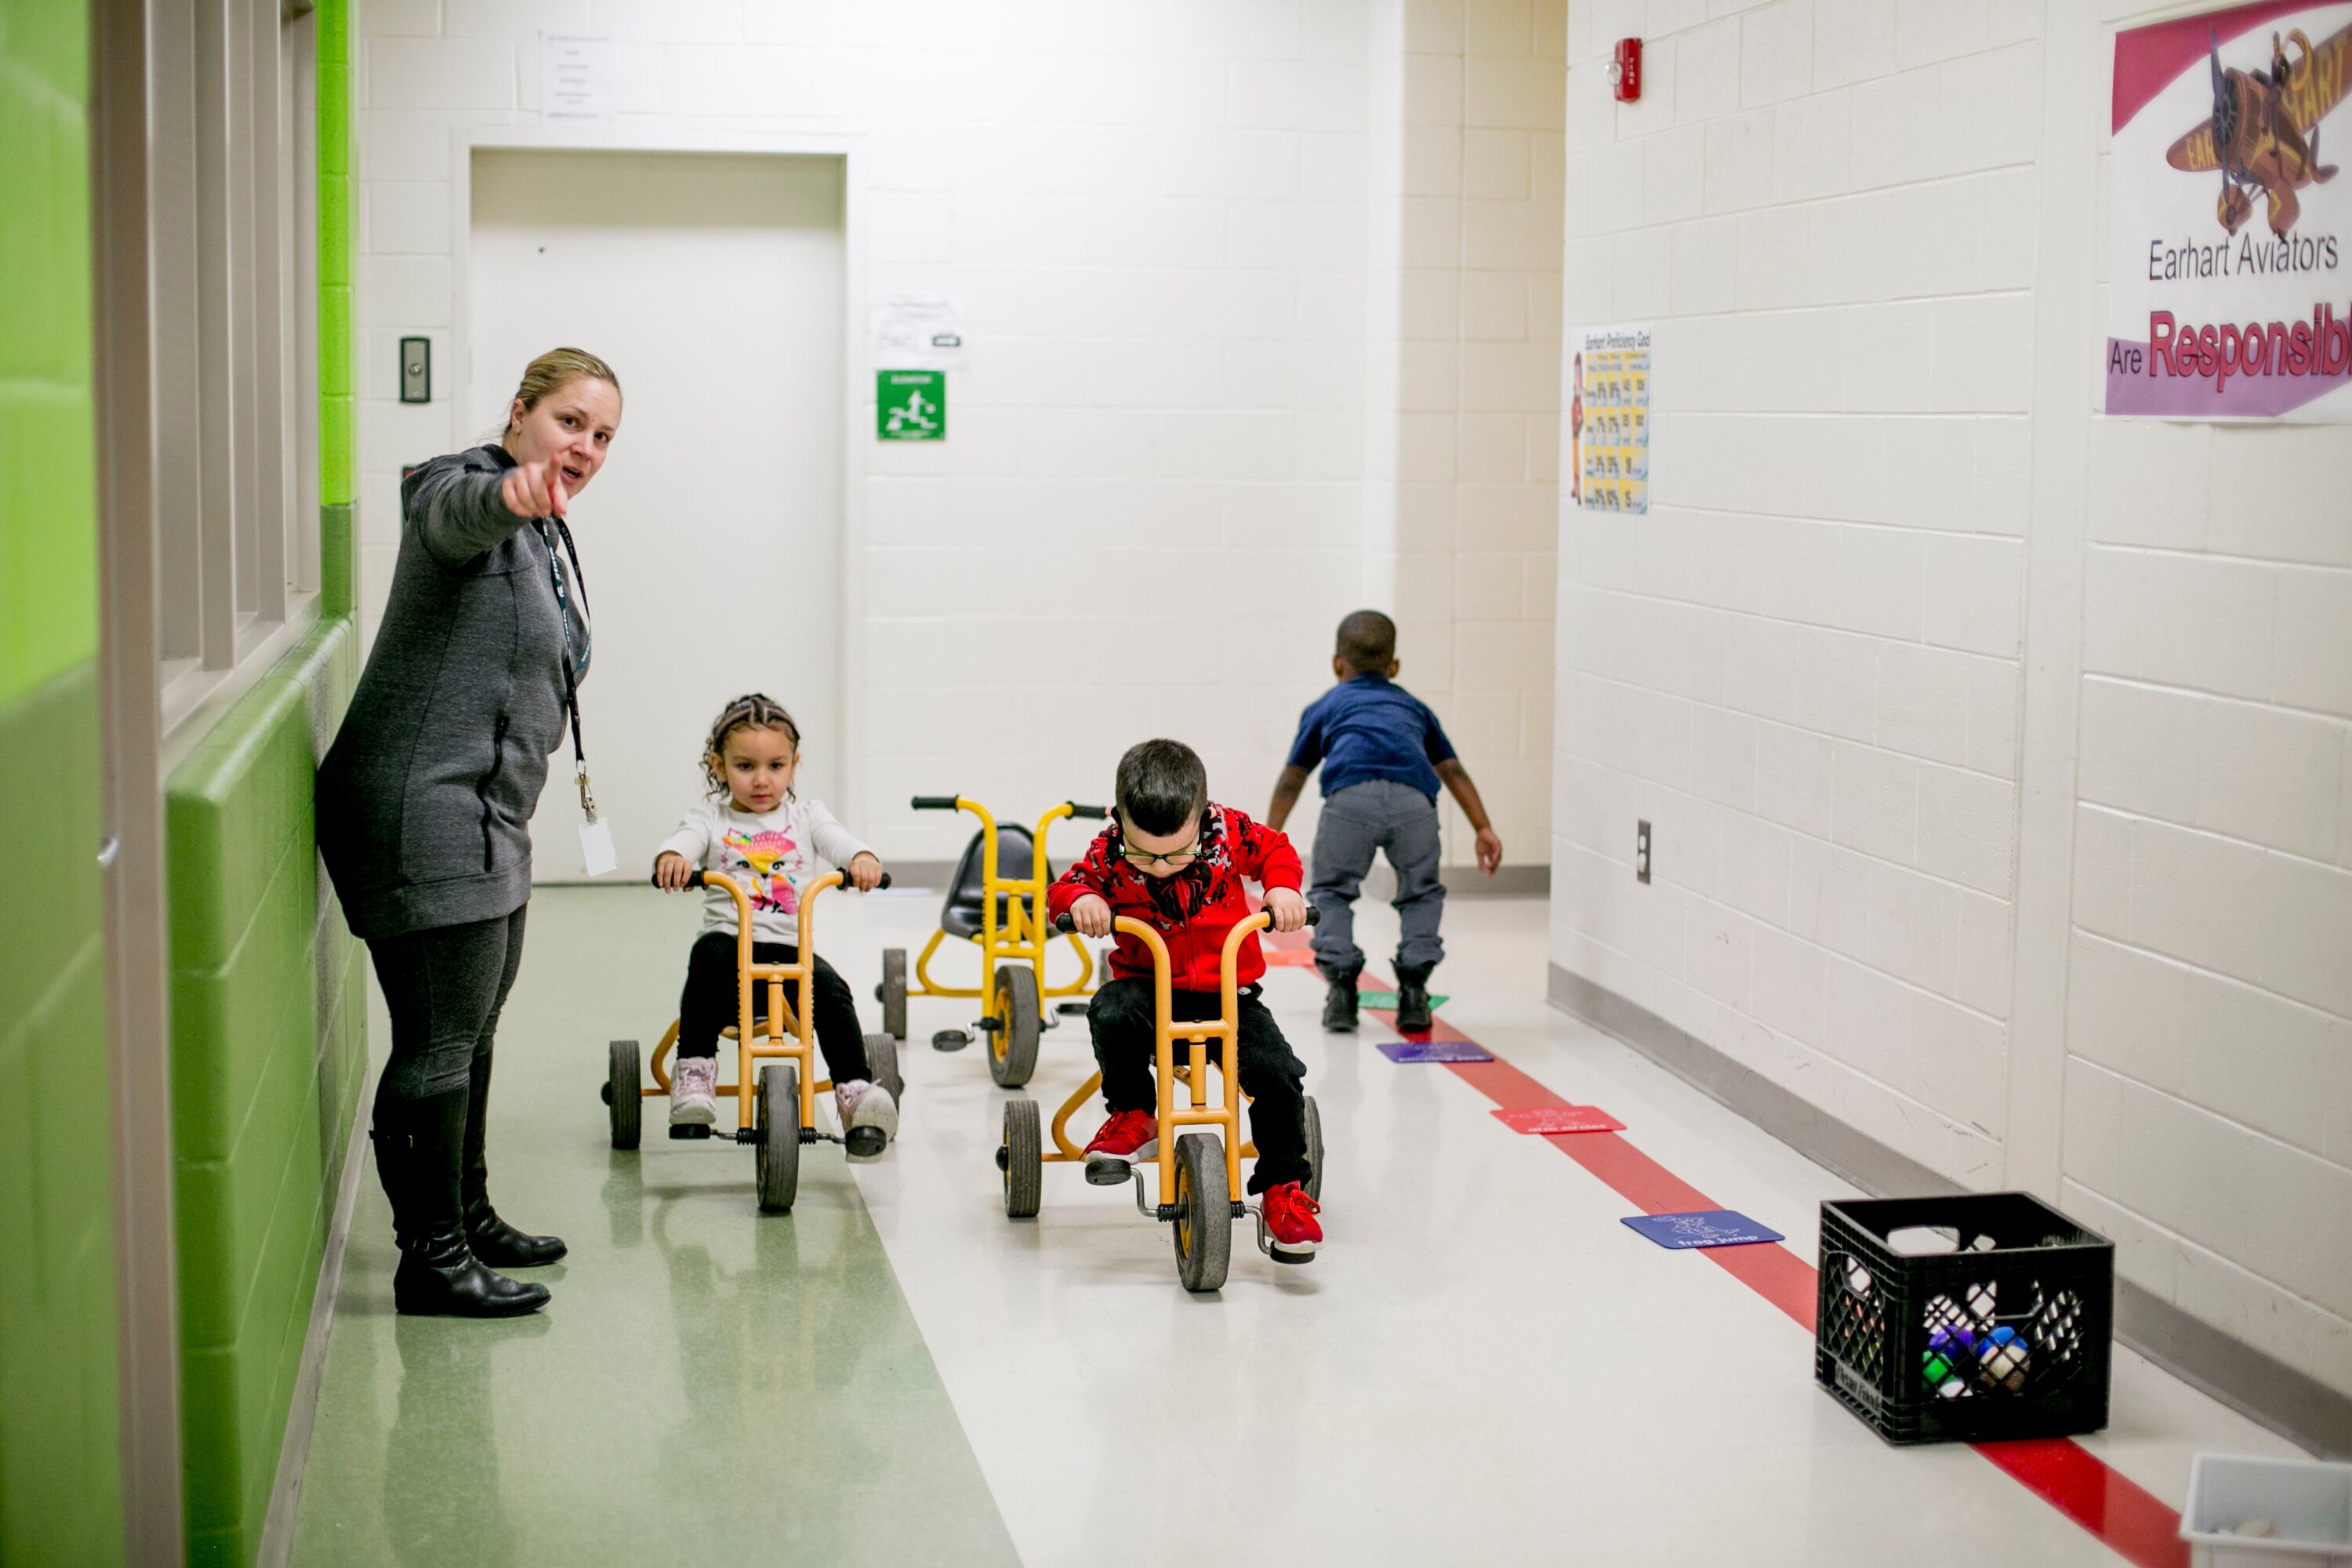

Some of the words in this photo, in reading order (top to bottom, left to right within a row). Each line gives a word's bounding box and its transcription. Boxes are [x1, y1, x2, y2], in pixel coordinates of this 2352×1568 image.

[2150, 237, 2230, 280] Earhart
[2237, 230, 2338, 275] Aviators
[2110, 340, 2142, 374] Are
[1716, 1234, 1759, 1243] jump
